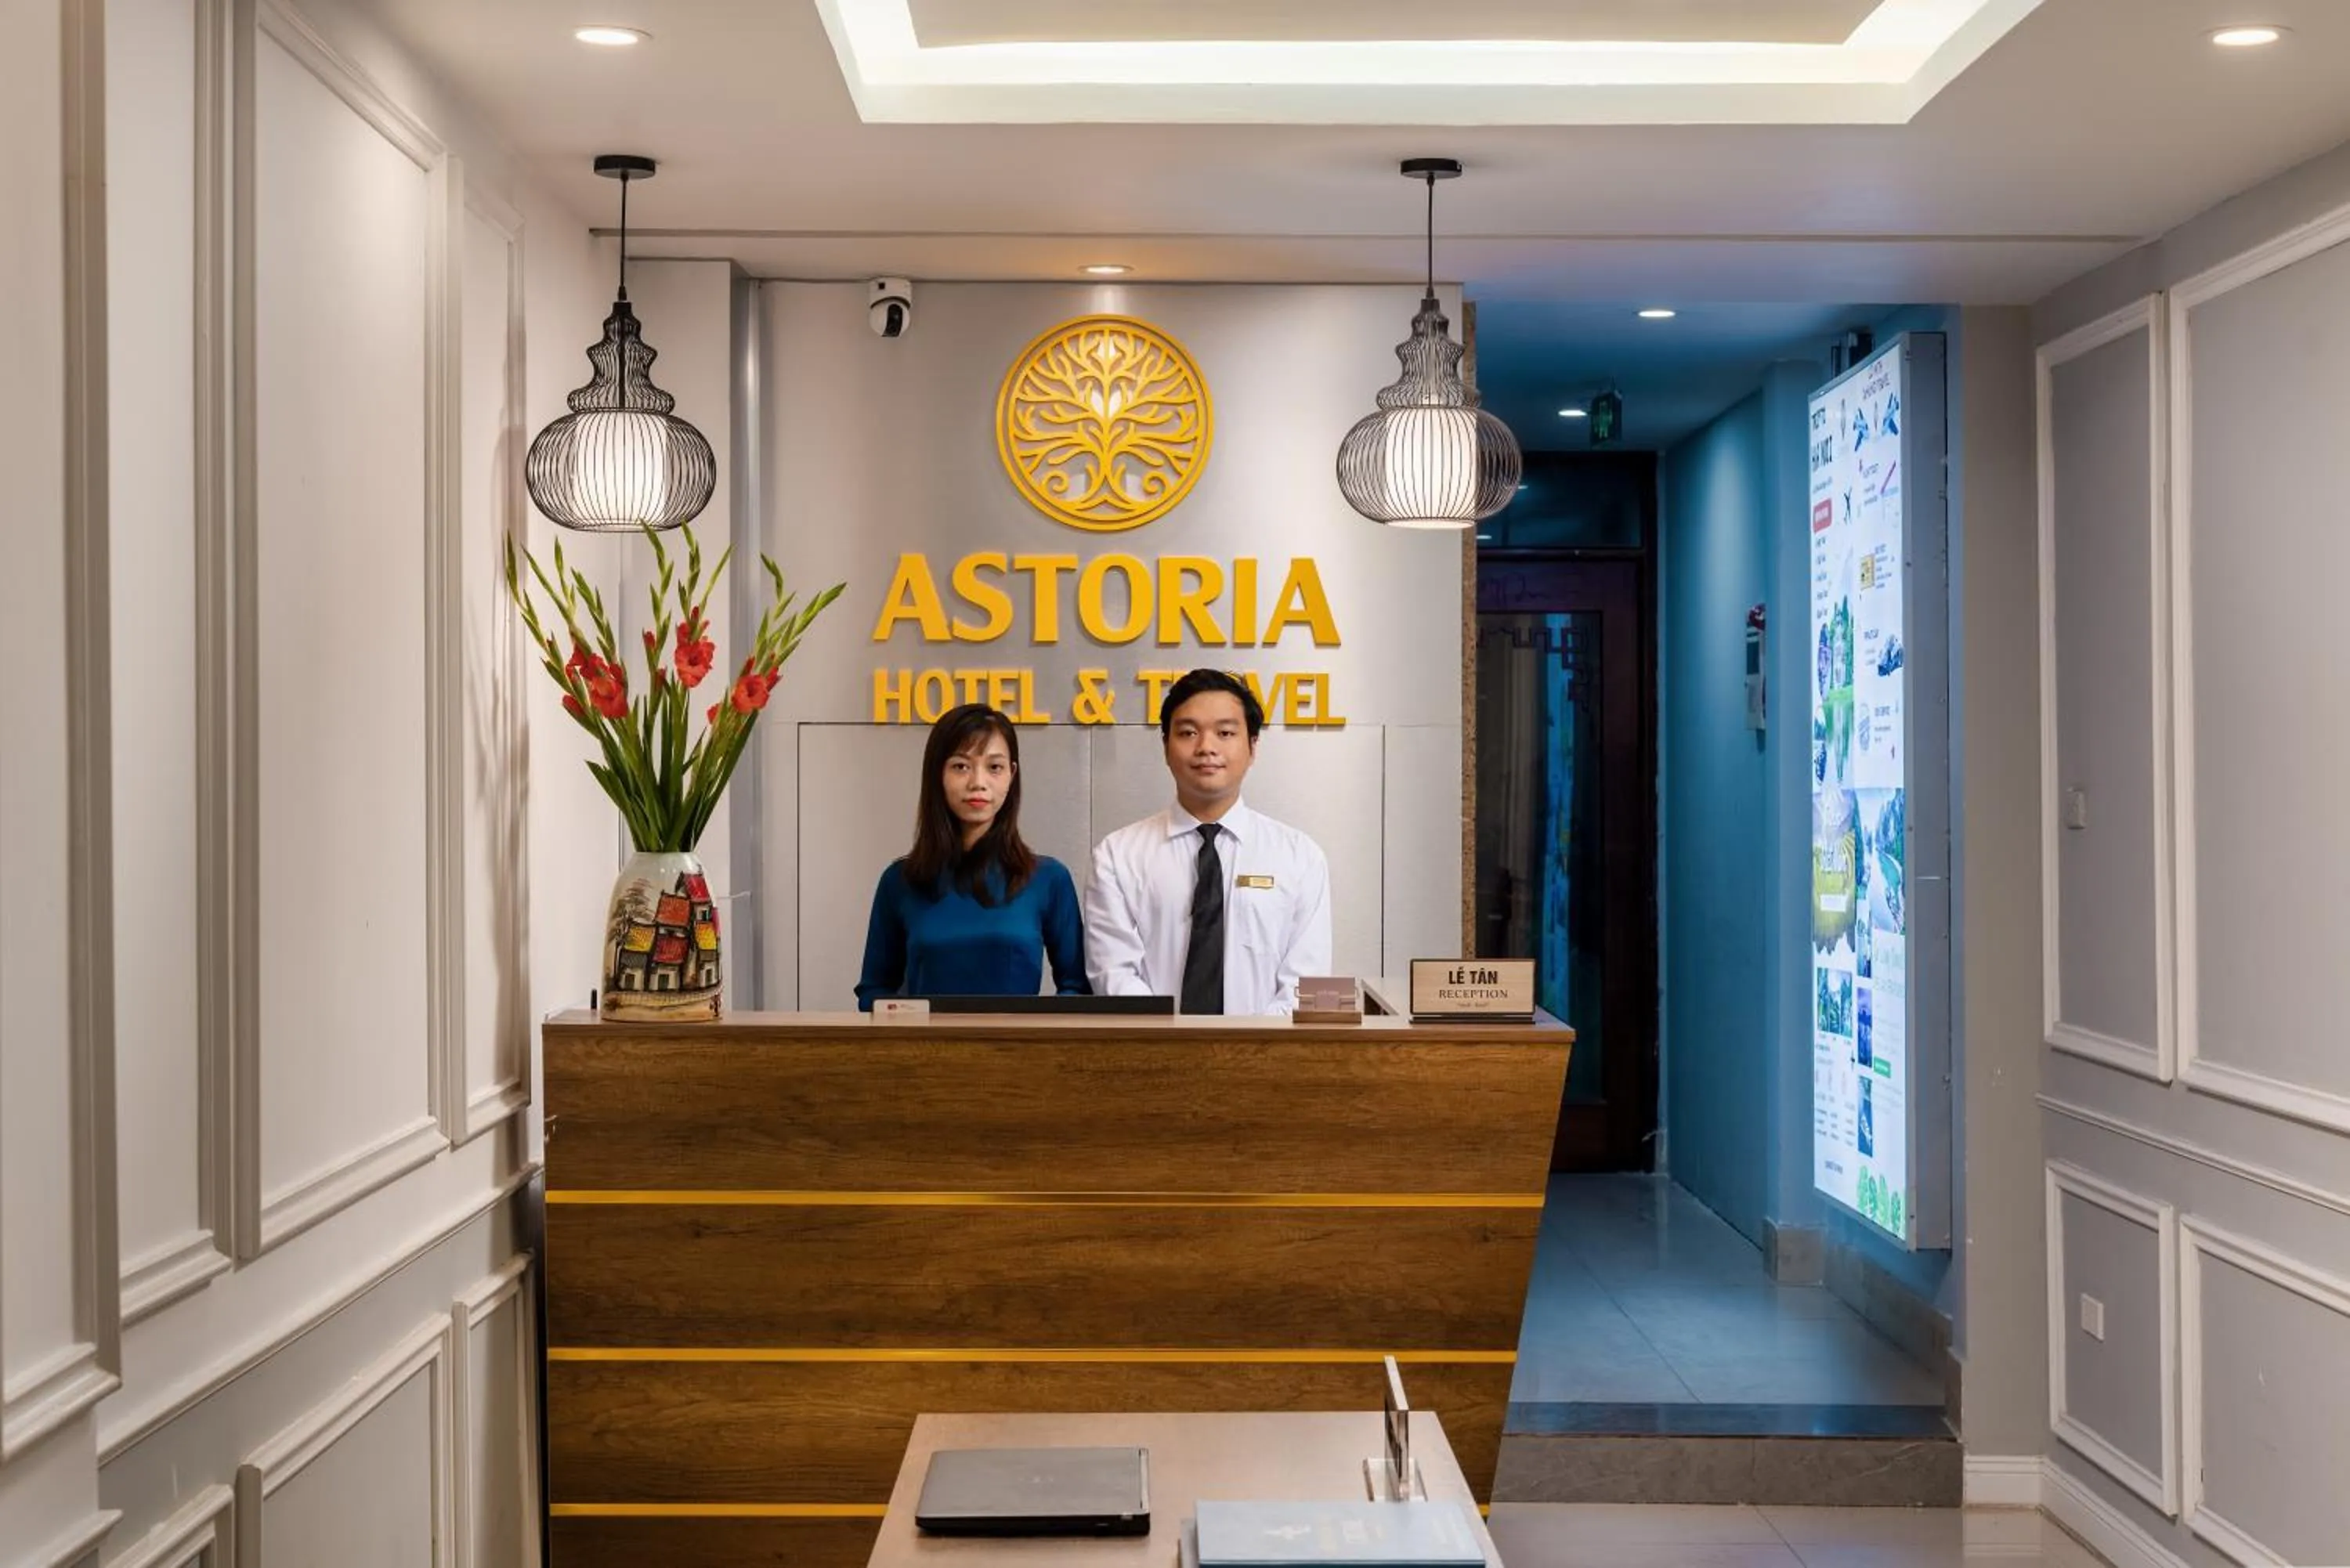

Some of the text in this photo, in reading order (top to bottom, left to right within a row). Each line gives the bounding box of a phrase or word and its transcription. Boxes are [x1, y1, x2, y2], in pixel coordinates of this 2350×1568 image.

[873, 551, 1341, 645] ASTORIA
[873, 668, 1346, 726] HOTEL & TVEL
[1439, 989, 1508, 999] RECEPTION
